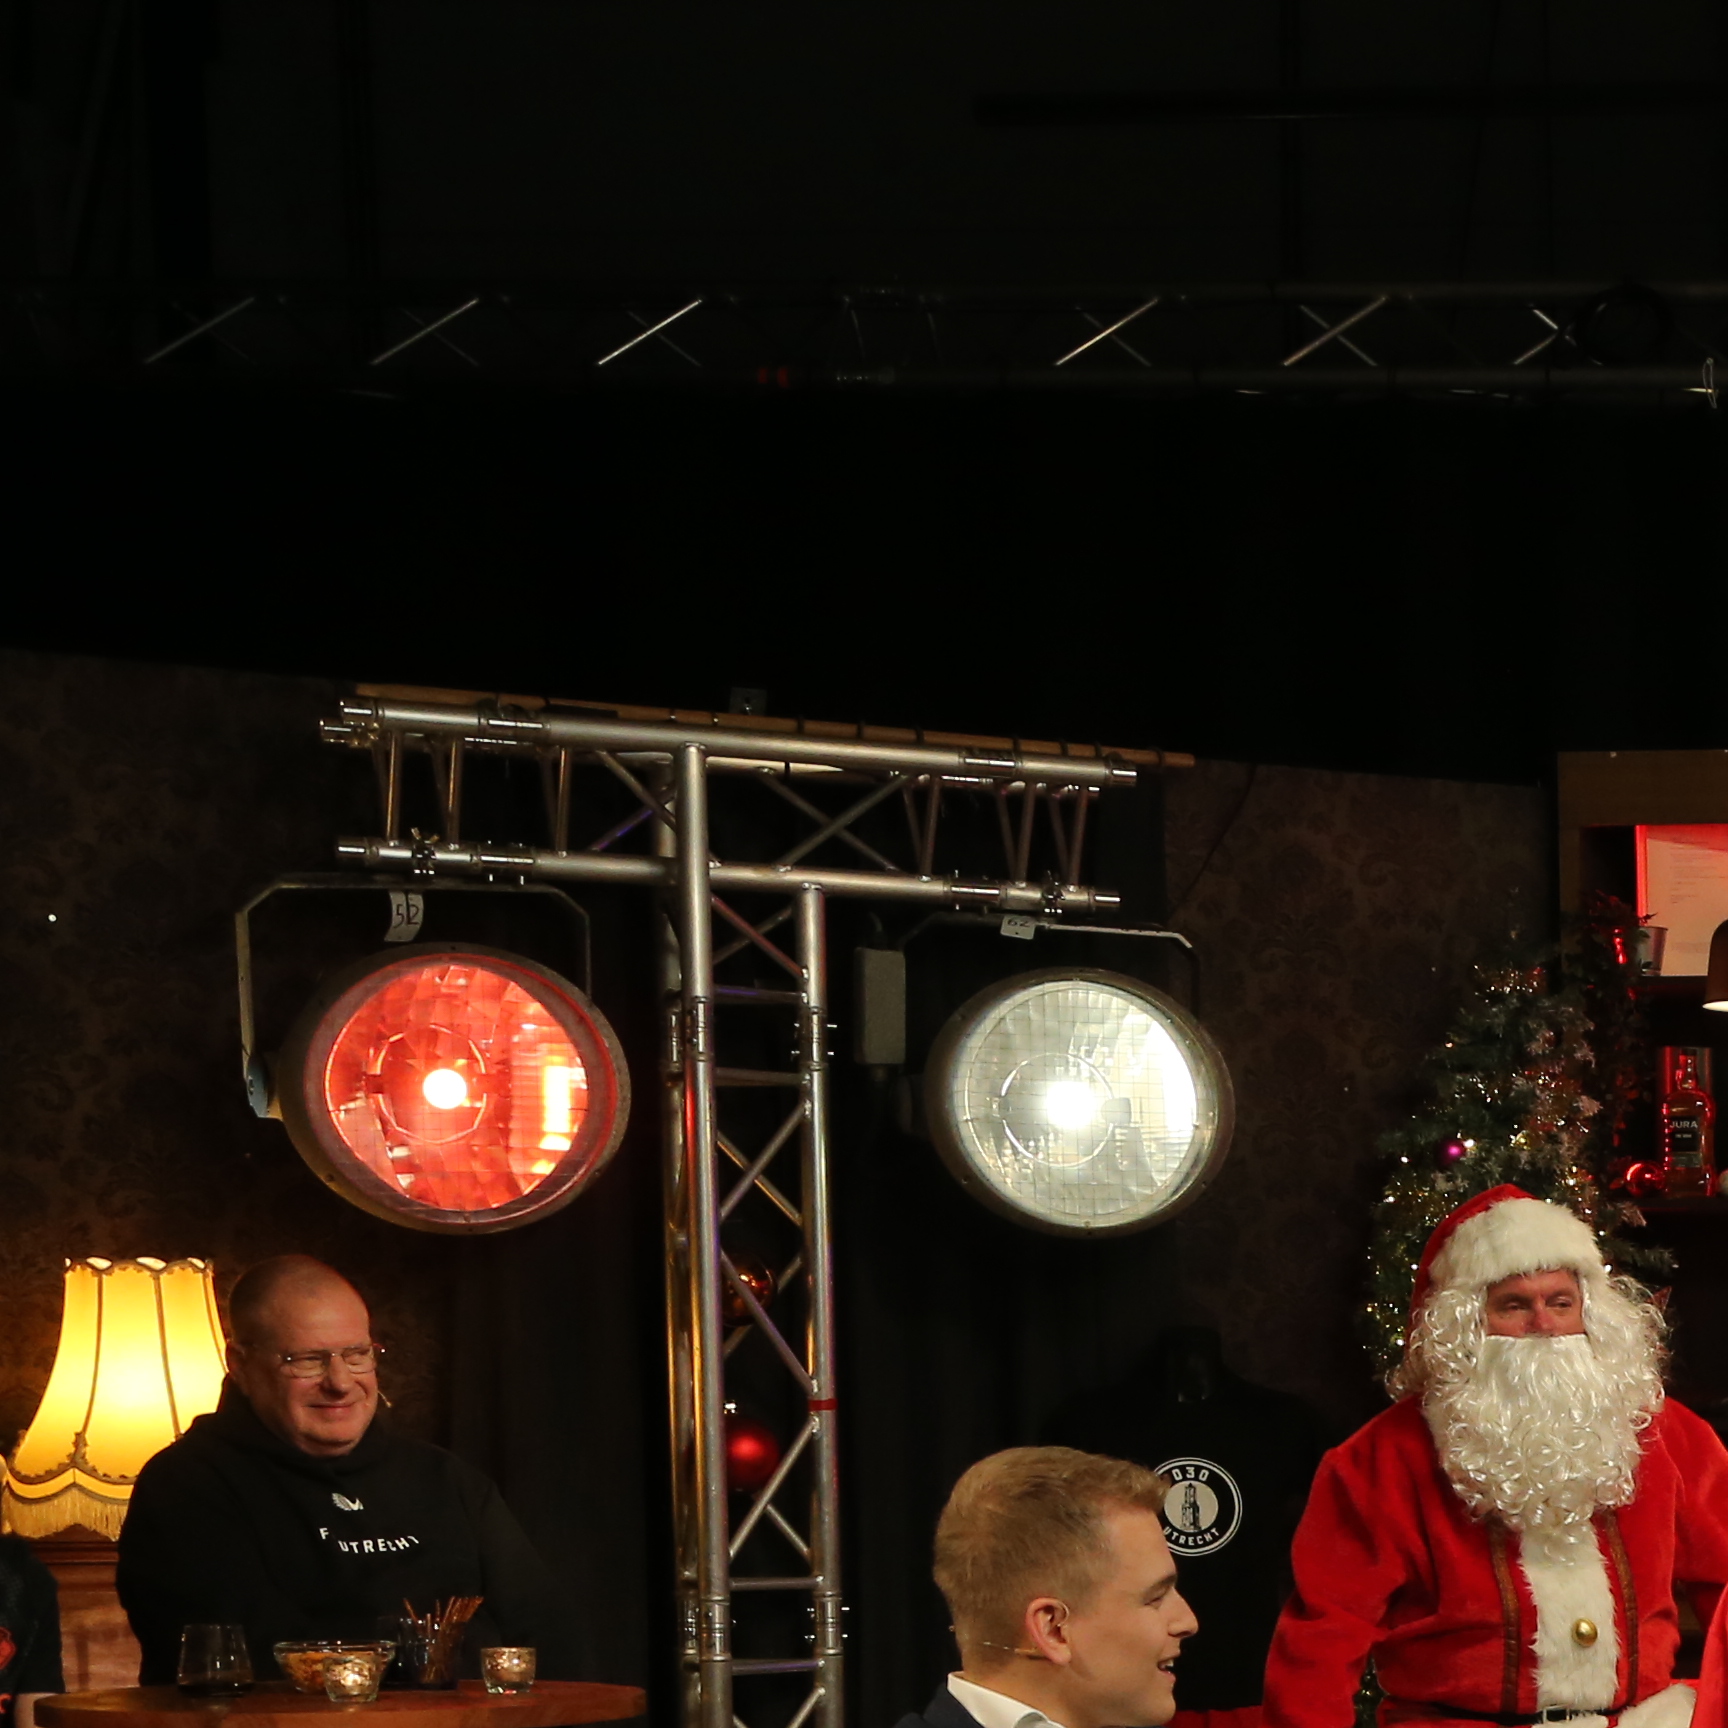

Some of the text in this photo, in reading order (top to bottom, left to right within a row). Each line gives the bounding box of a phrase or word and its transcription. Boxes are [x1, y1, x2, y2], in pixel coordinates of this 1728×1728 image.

[1669, 1120, 1698, 1129] JURA
[1171, 1465, 1210, 1482] 030
[1162, 1525, 1220, 1546] UTRECHT
